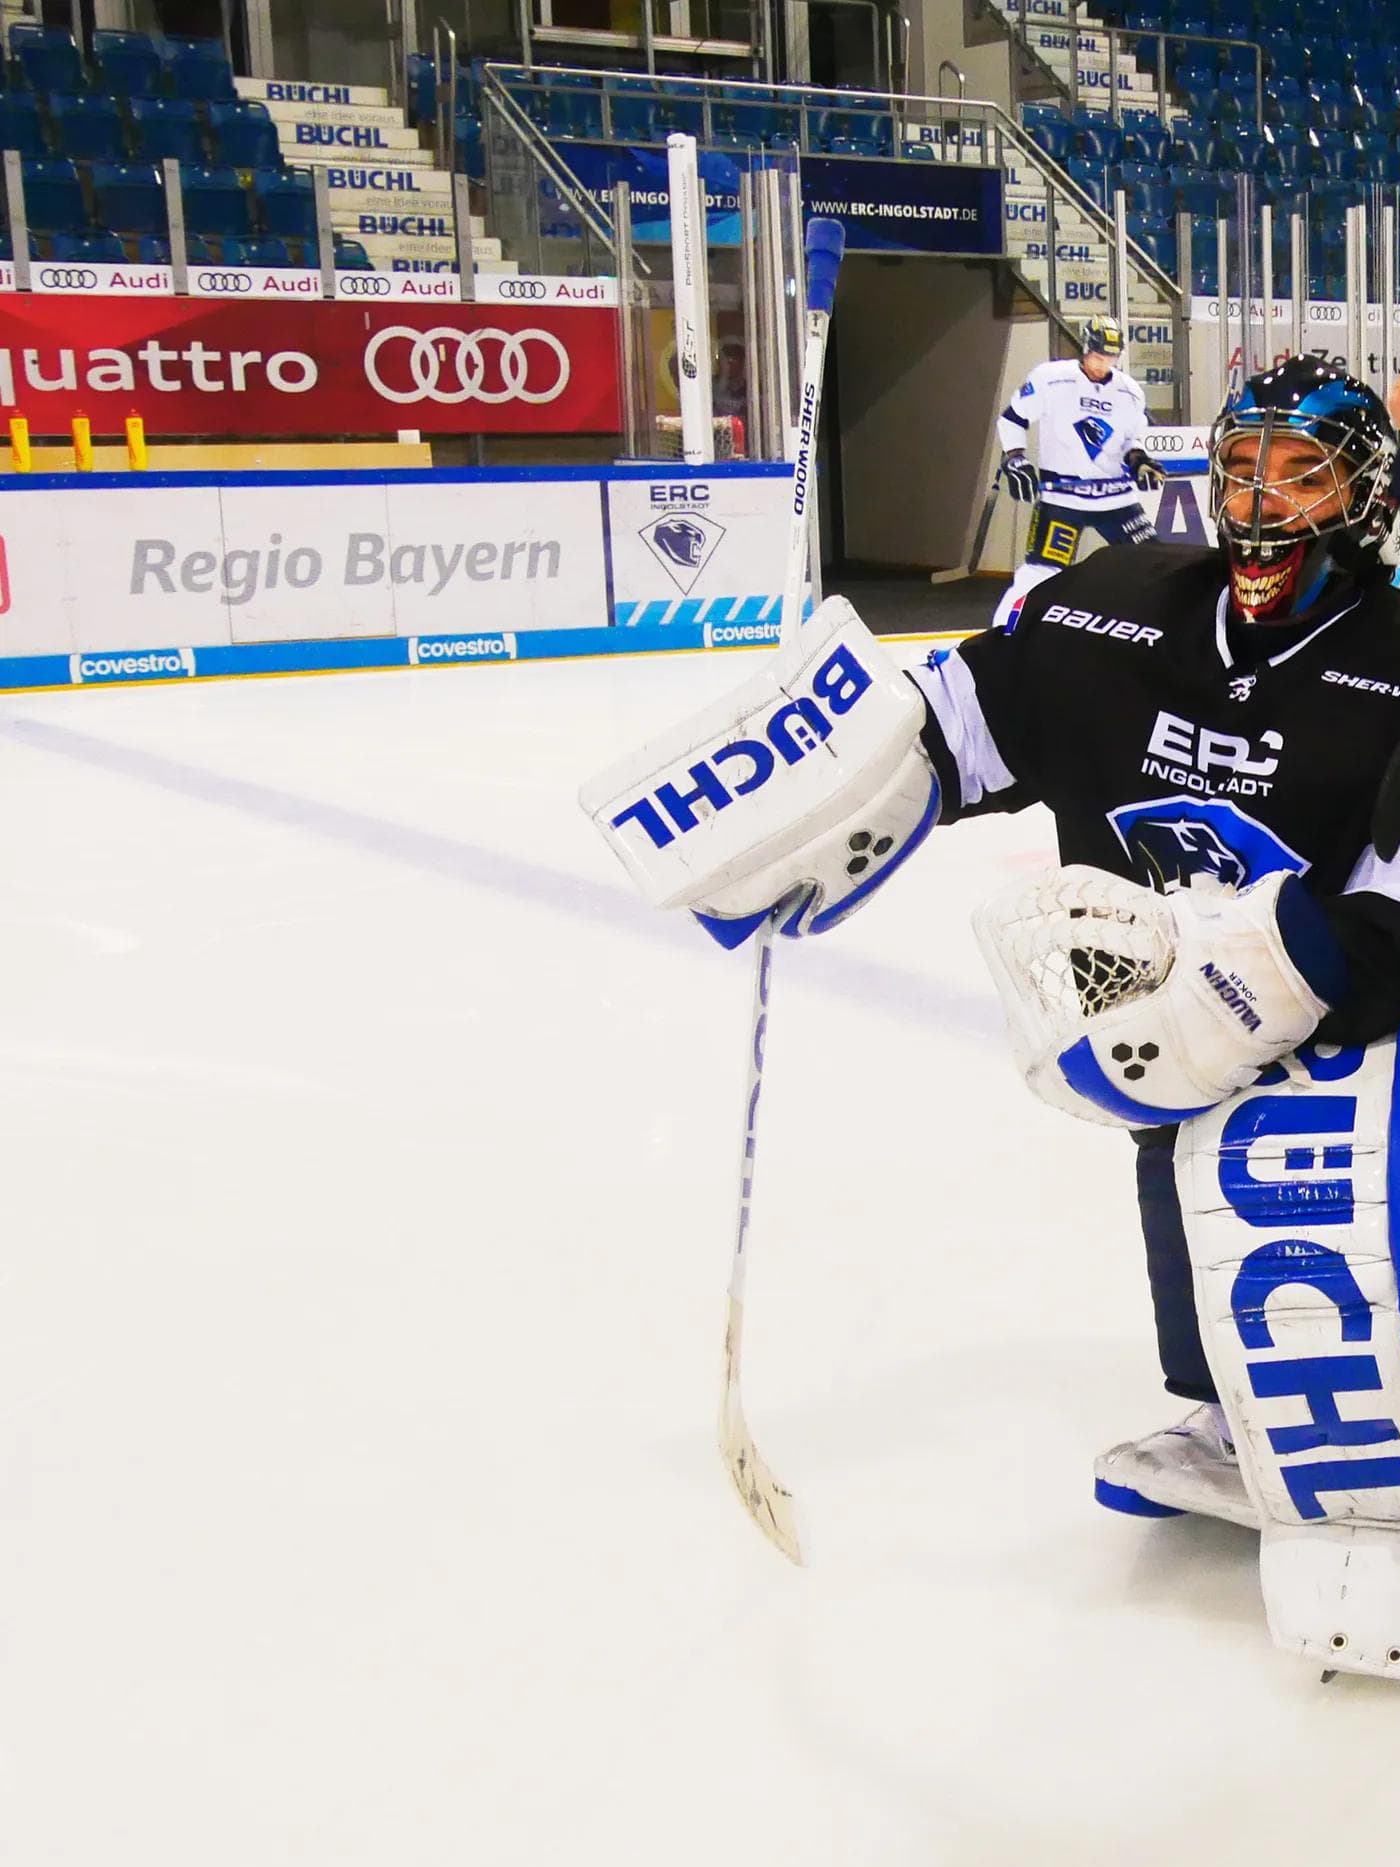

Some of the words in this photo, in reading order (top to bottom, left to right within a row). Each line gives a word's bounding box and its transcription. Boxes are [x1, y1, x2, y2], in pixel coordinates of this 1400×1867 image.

[296, 124, 388, 148] BÜCHL
[328, 168, 421, 192] BÜCHL
[811, 200, 978, 222] WWW.ERC-INGOLSTADT.DE
[358, 215, 453, 237] BÜCHL
[109, 271, 169, 289] Audi
[263, 275, 319, 292] Audi
[401, 279, 454, 296] Audi
[556, 283, 605, 300] Audi
[1080, 397, 1113, 412] ERC
[650, 485, 710, 501] ERC
[650, 502, 711, 510] INGOLSTADT
[130, 533, 323, 606] Regio
[344, 532, 562, 596] Bayern
[1041, 604, 1164, 647] BAUER
[418, 635, 505, 658] covestro
[80, 653, 182, 677] covestro
[611, 642, 874, 850] BÜCHL
[1200, 962, 1263, 1035] VAUGHN
[1228, 972, 1258, 1003] JOKER
